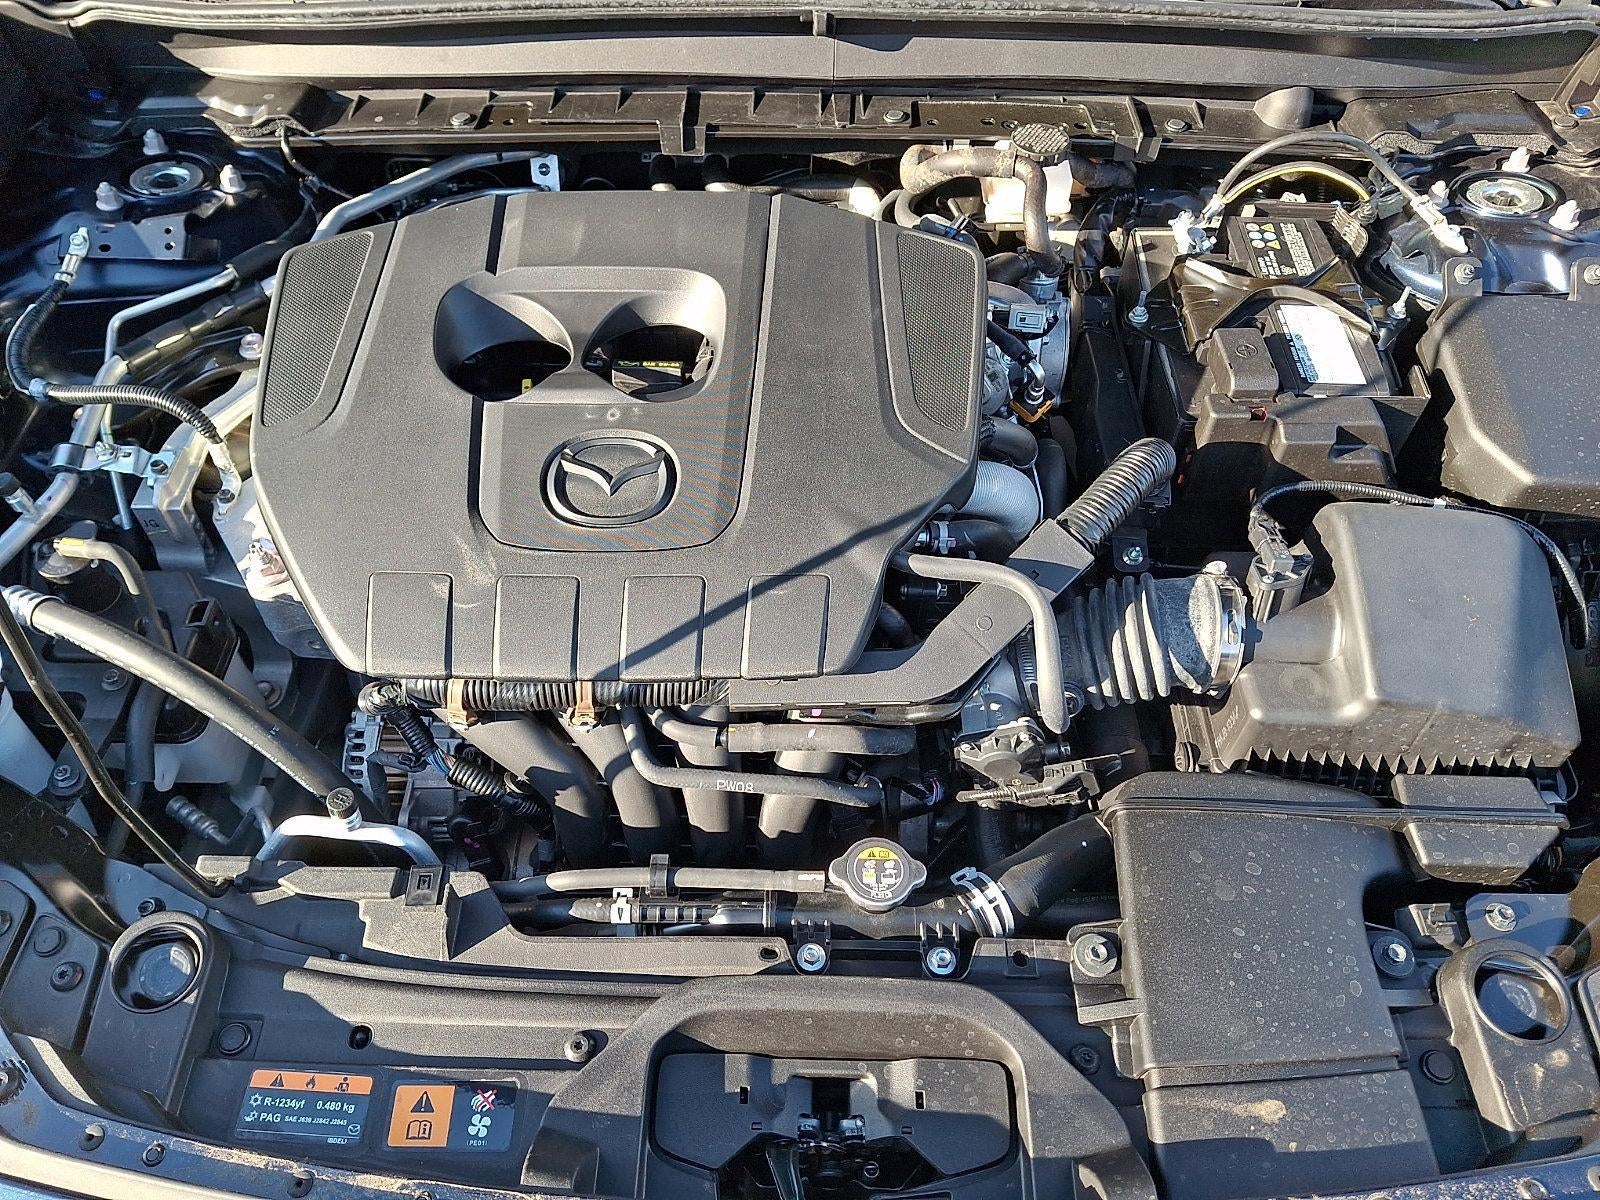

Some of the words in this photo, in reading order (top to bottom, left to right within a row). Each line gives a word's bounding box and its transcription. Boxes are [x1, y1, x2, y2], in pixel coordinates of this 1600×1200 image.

[717, 779, 754, 793] PW08
[264, 1097, 305, 1110] R-1234yf
[317, 1100, 341, 1111] 0.480
[342, 1102, 355, 1113] kg
[259, 1112, 281, 1123] PAG
